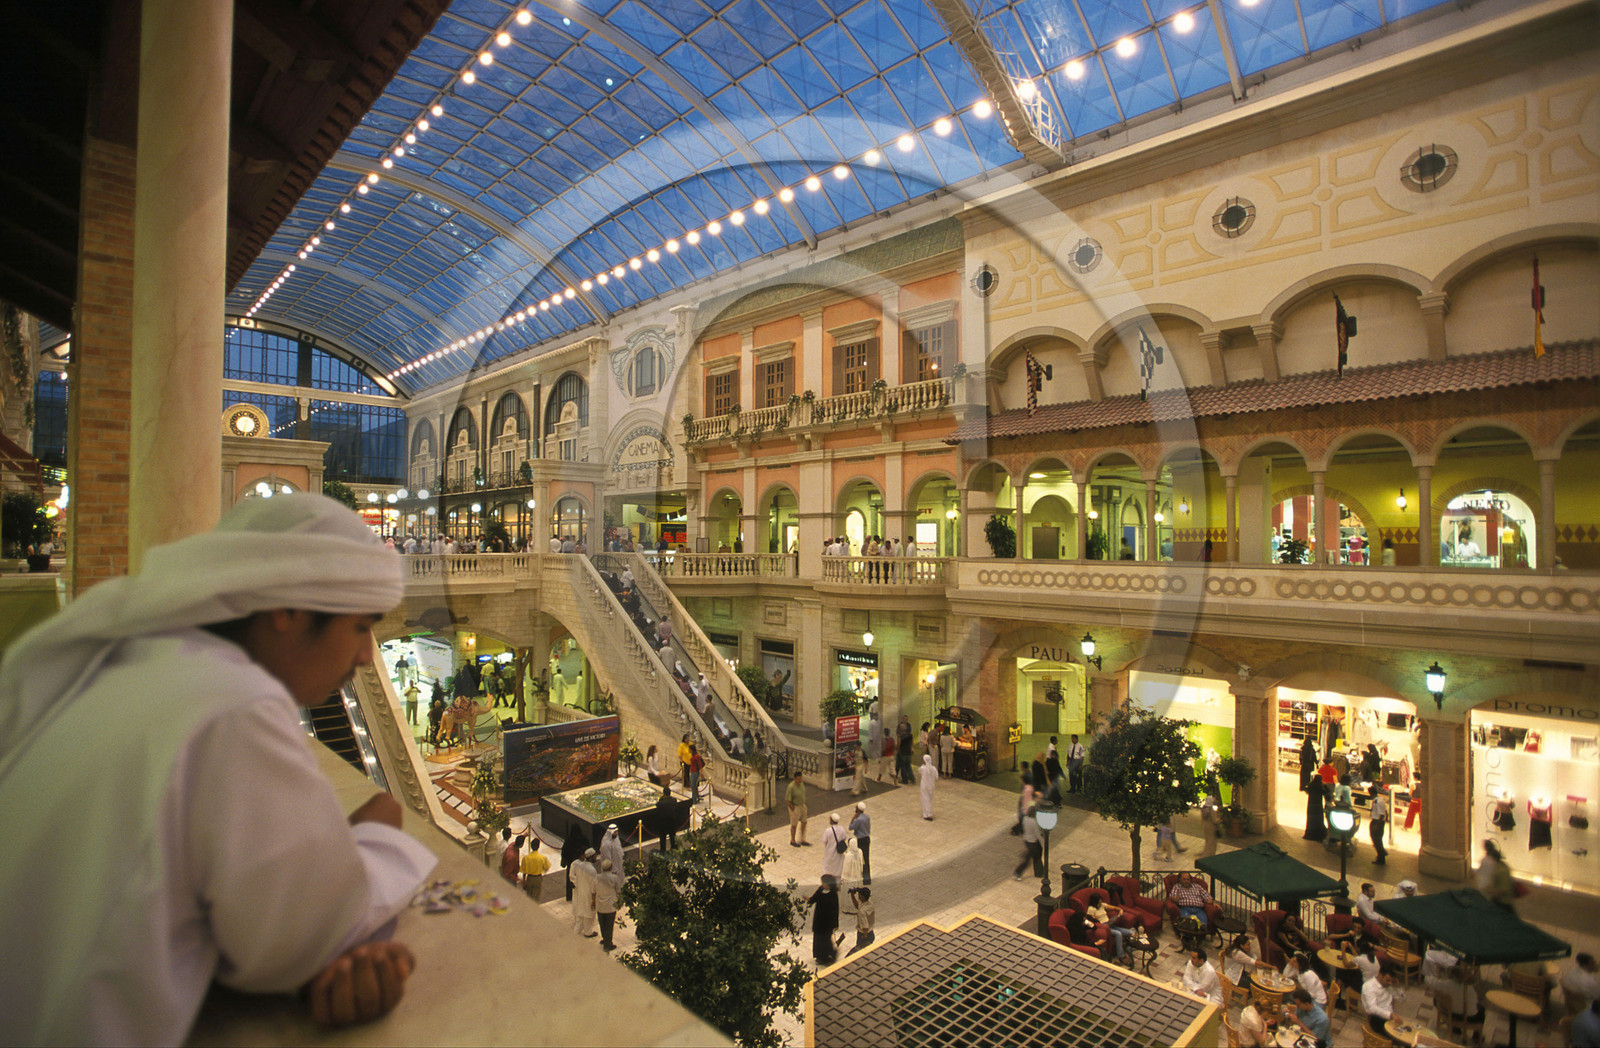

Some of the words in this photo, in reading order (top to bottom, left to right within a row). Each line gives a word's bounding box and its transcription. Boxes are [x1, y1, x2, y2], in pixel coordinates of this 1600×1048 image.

[628, 441, 660, 457] CINEMA
[1031, 646, 1076, 663] PAUL
[1494, 699, 1599, 720] promo
